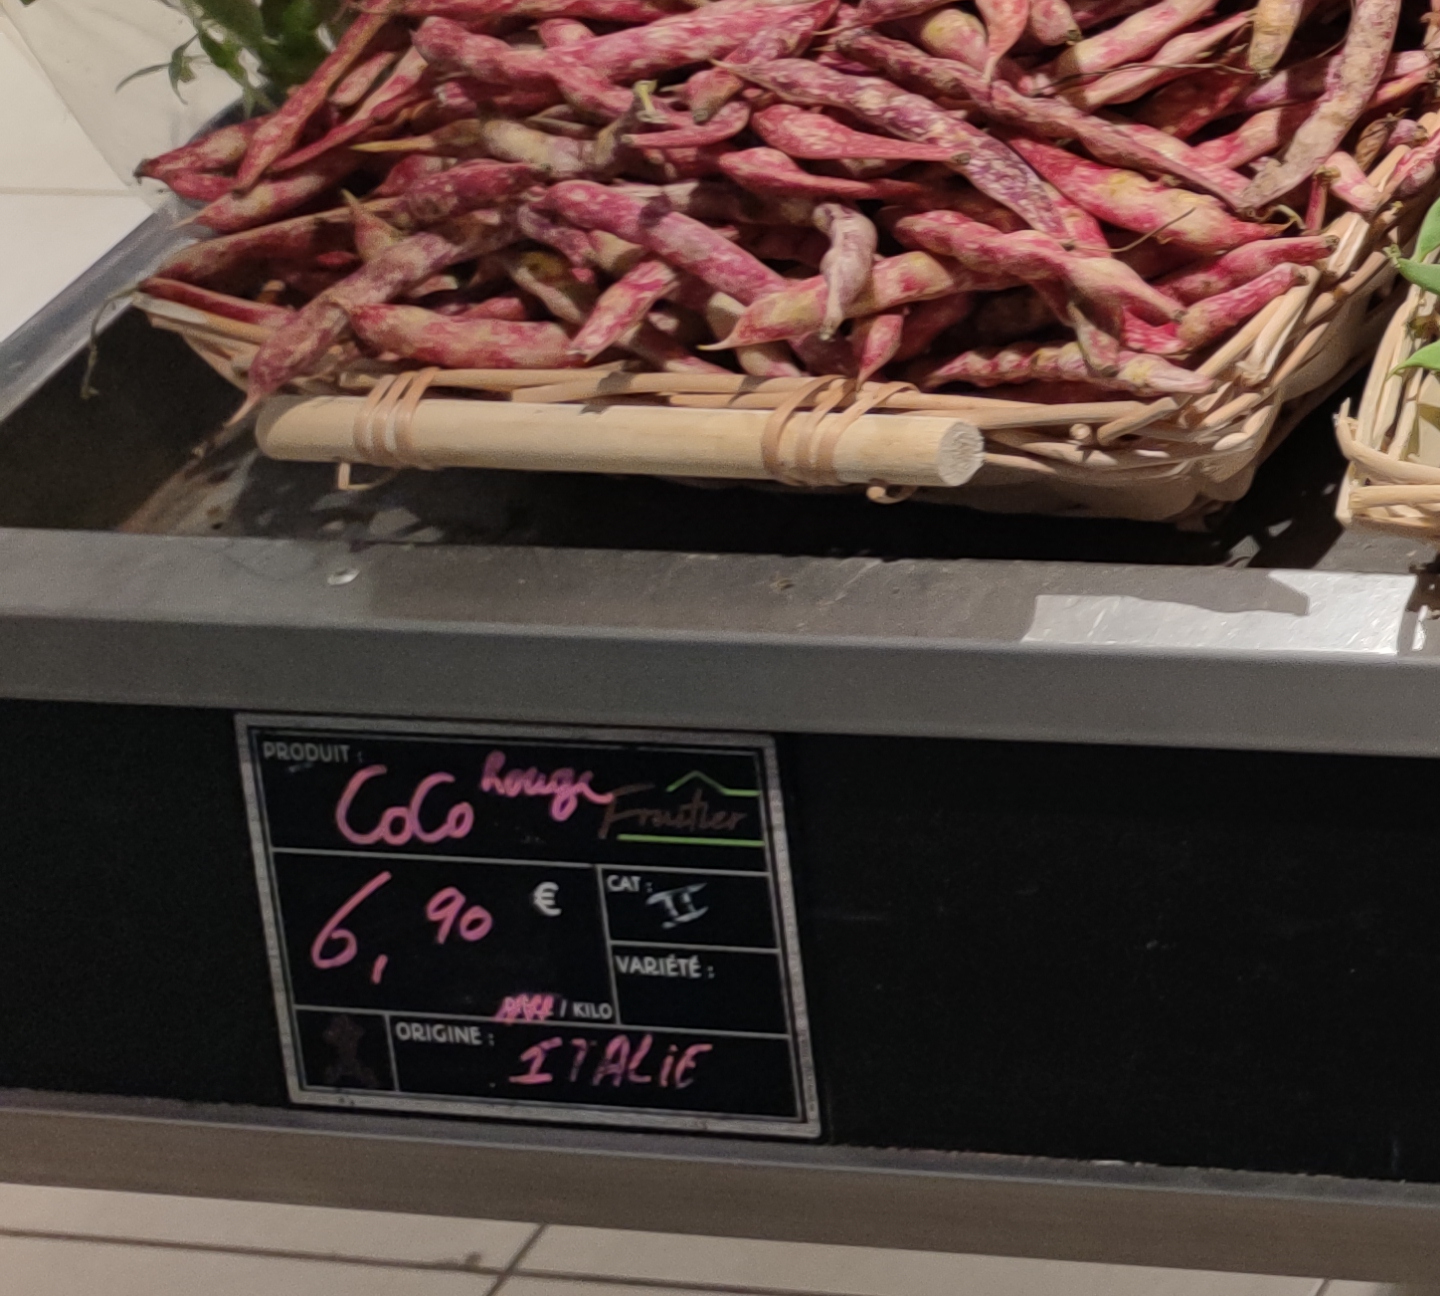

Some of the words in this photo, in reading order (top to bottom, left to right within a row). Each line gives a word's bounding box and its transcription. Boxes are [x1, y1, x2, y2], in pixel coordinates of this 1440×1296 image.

[263, 741, 350, 764] PRODUIT
[606, 874, 641, 892] CAT
[532, 880, 562, 917] €
[614, 952, 701, 978] VARIÉTÉ
[573, 1002, 612, 1020] KILO
[395, 1021, 482, 1046] ORIGINE
